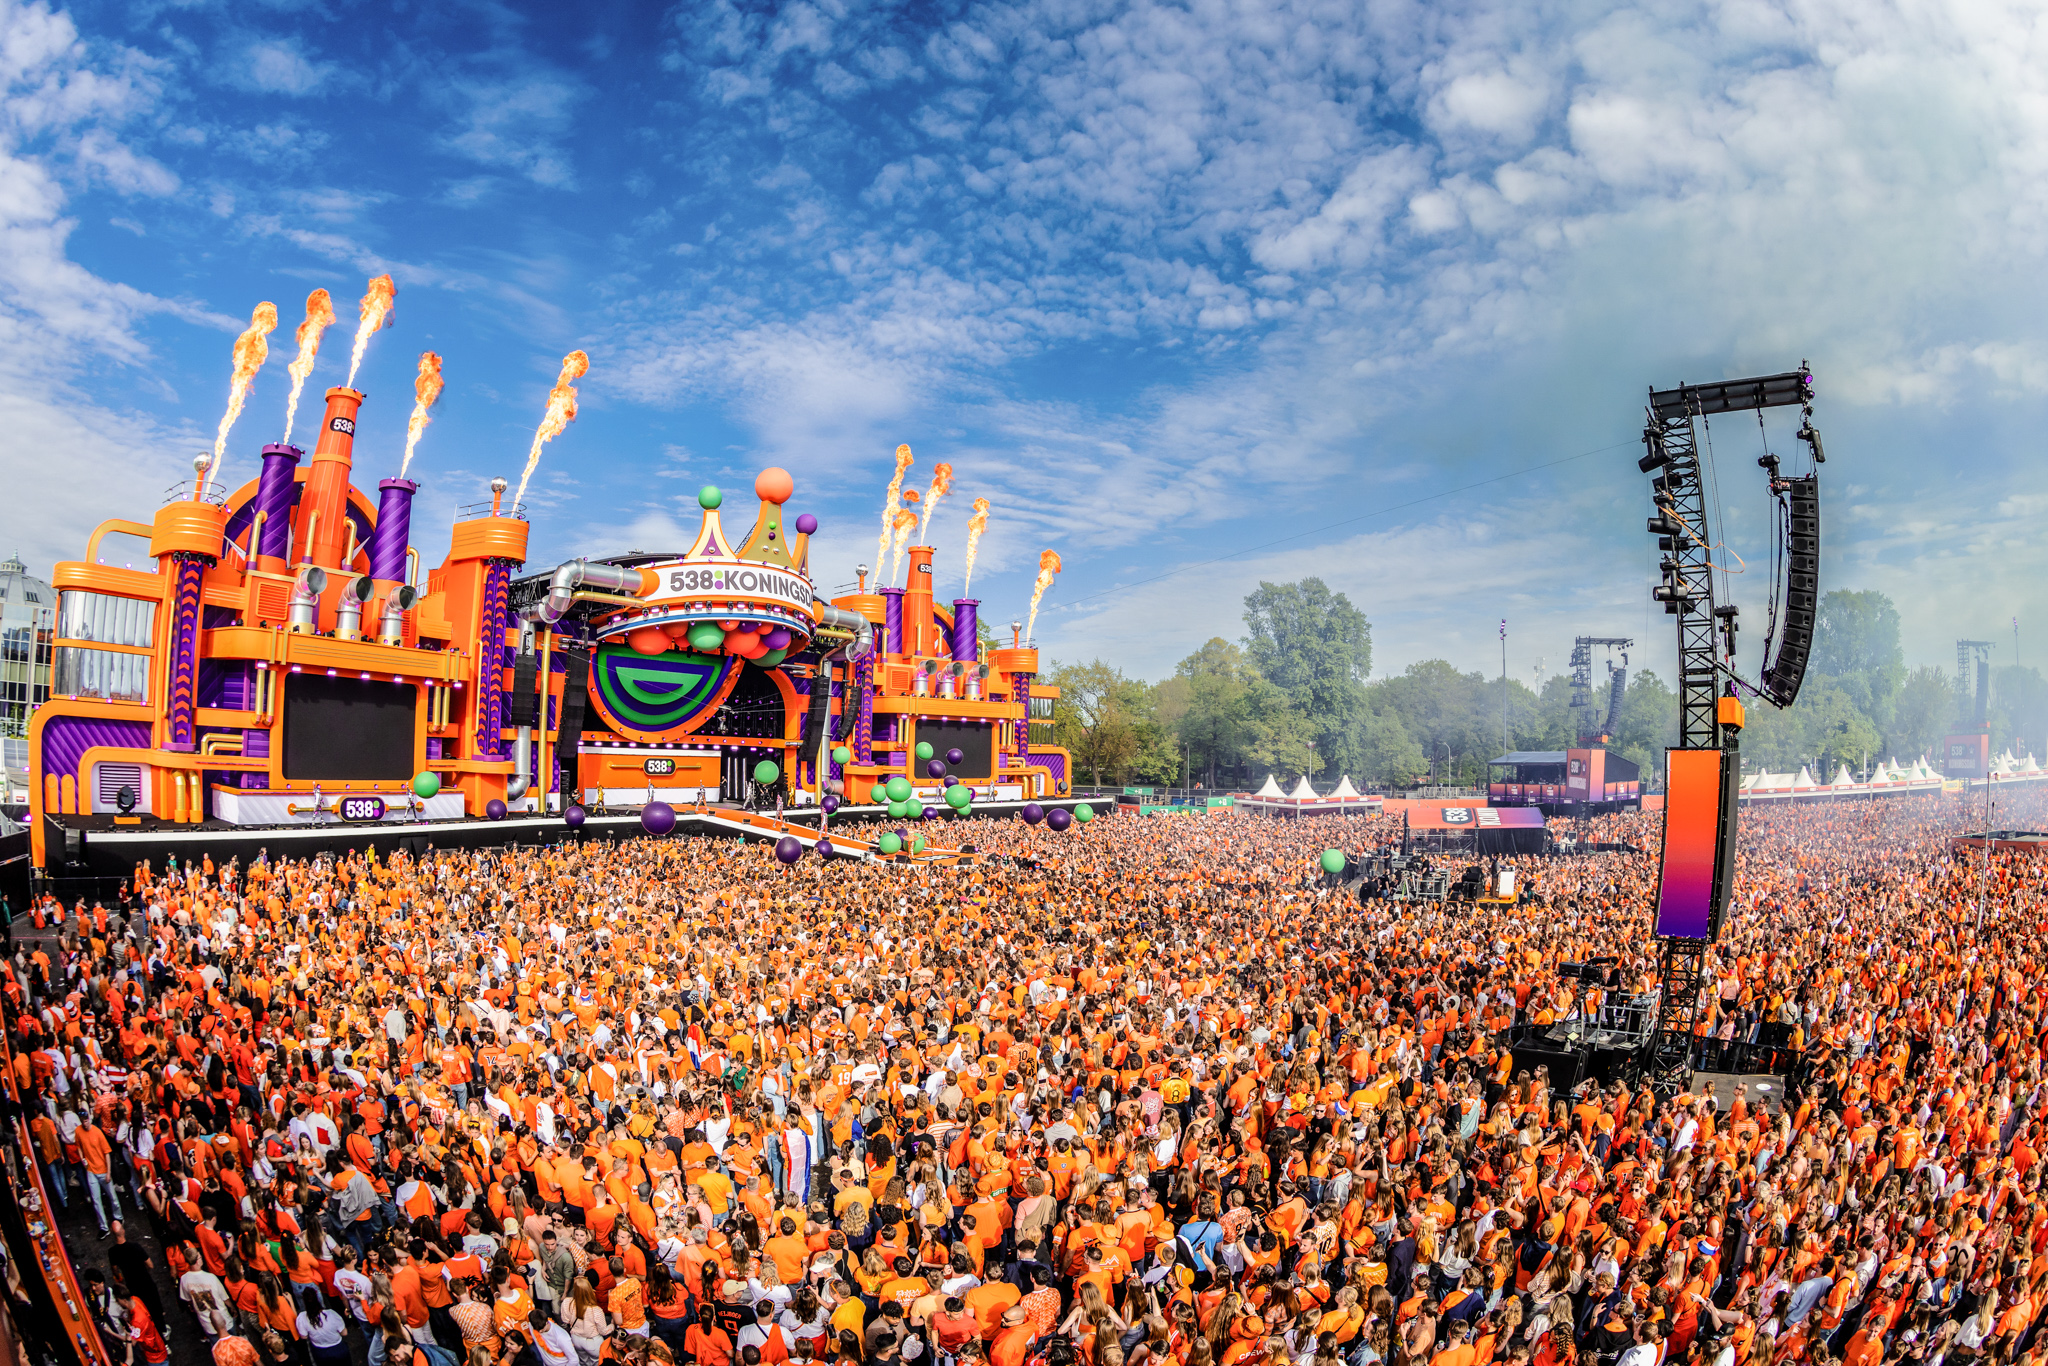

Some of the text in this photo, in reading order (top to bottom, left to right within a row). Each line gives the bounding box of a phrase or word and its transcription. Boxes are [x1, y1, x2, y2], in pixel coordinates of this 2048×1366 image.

[333, 418, 353, 434] 538
[647, 760, 668, 773] 538
[345, 800, 374, 818] 538
[1018, 1049, 1028, 1062] 10
[838, 1071, 850, 1086] 19
[1171, 1089, 1180, 1103] 8
[1238, 1349, 1265, 1361] CREW
